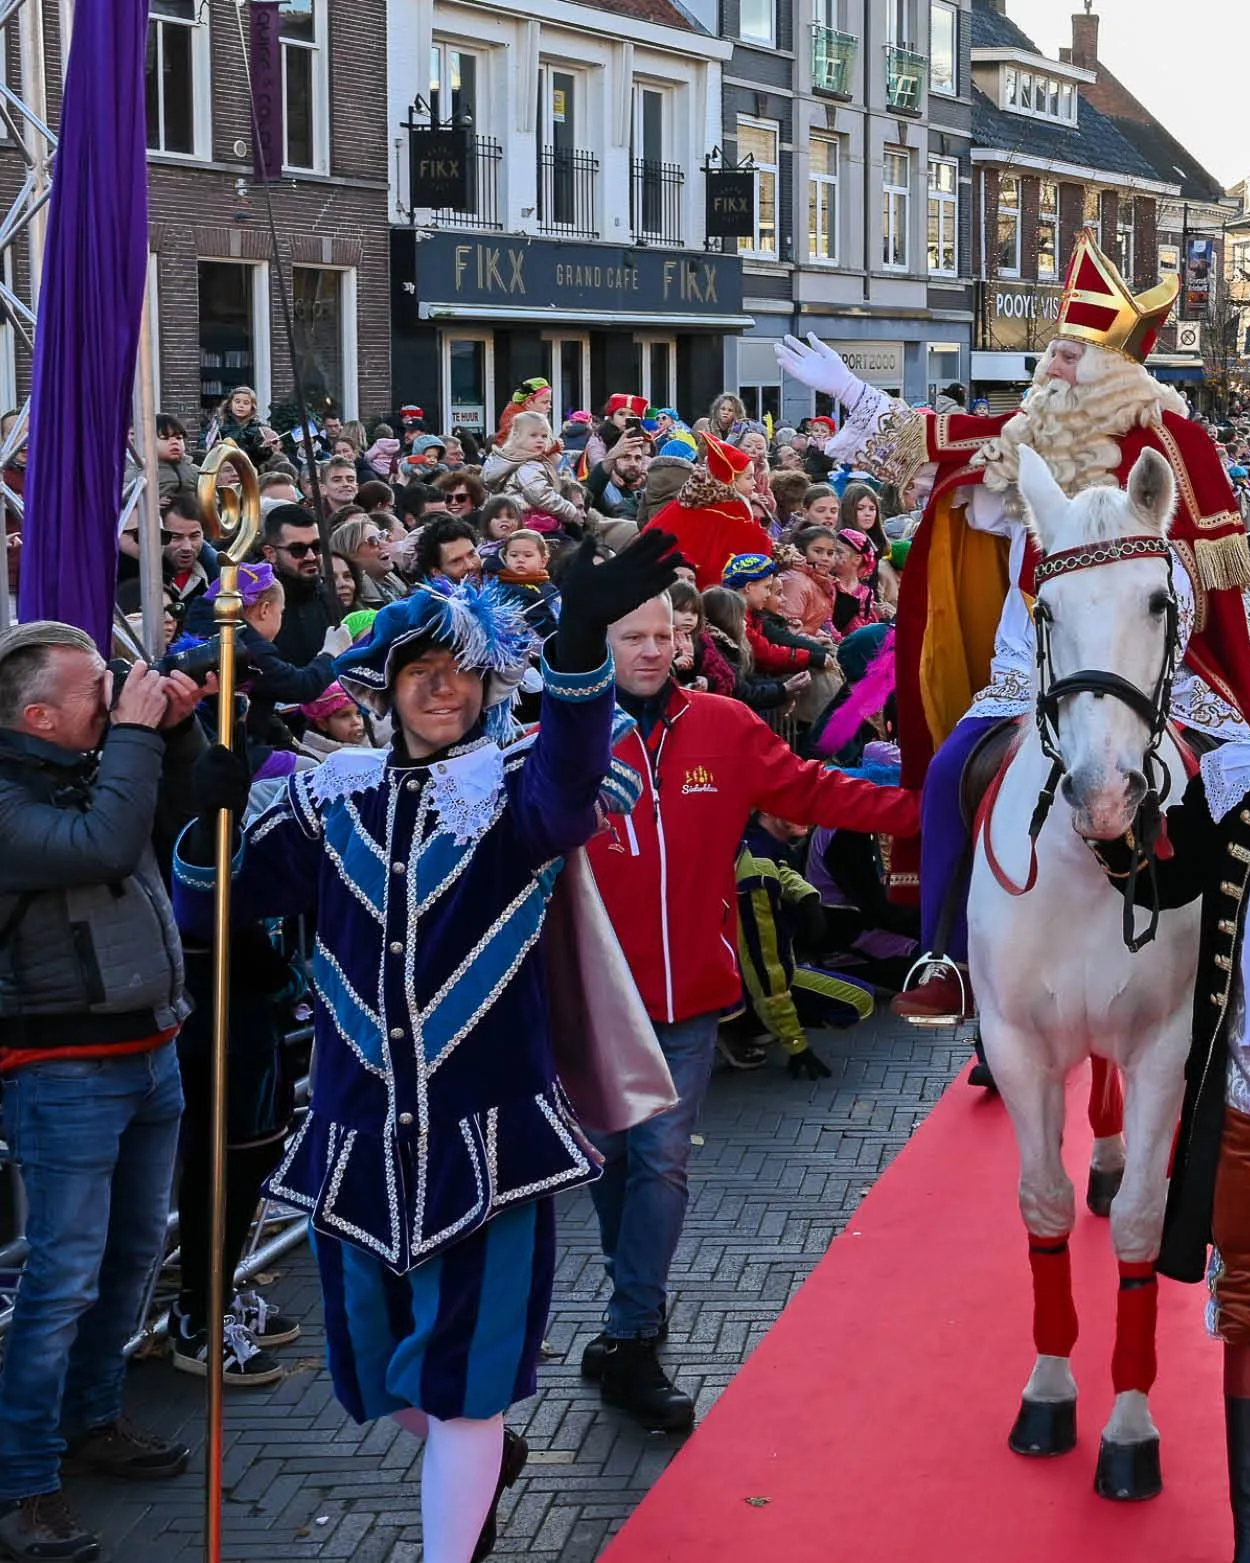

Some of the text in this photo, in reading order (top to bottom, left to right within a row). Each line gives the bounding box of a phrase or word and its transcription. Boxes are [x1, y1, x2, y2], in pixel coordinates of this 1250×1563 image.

[420, 160, 459, 178] FIKX
[714, 197, 748, 213] FIKX
[455, 243, 526, 295] FIKX
[556, 264, 600, 288] GRAND
[663, 260, 717, 304] FIKX
[839, 353, 896, 370] PORT2000
[452, 412, 479, 422] TE HUUR
